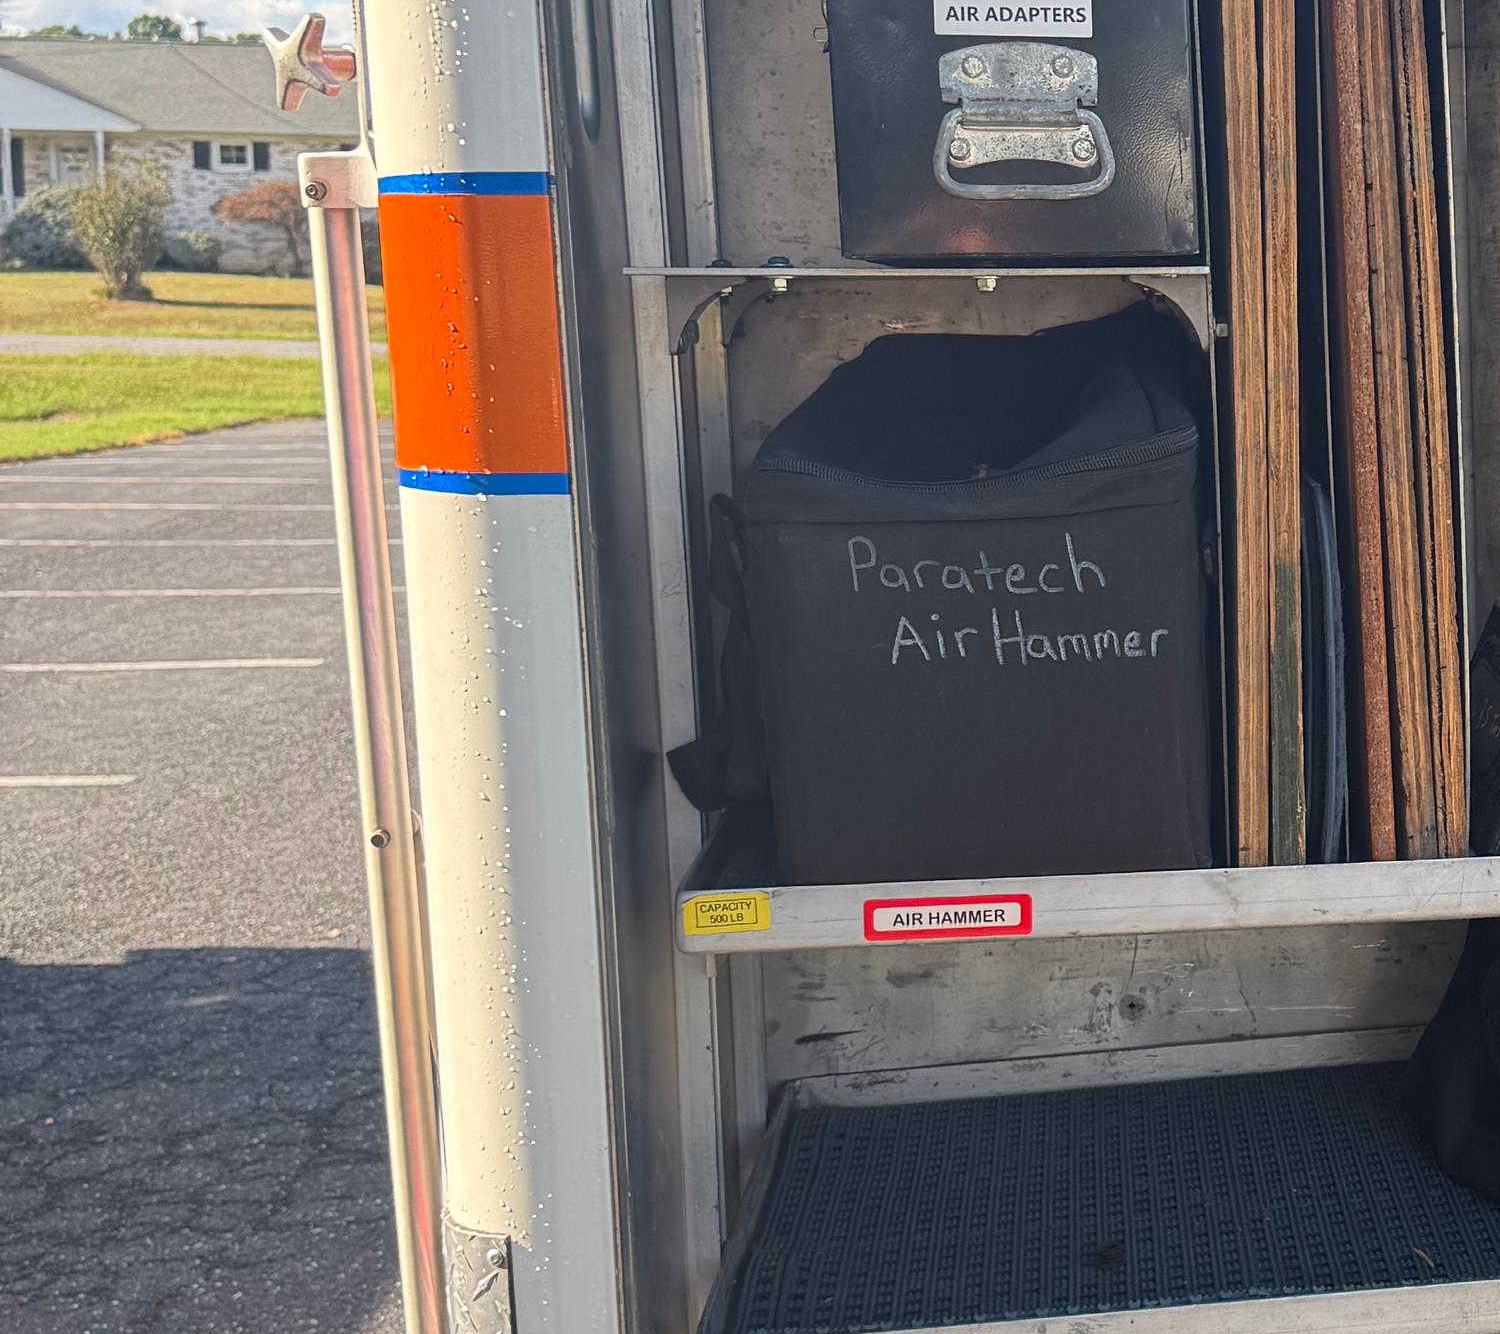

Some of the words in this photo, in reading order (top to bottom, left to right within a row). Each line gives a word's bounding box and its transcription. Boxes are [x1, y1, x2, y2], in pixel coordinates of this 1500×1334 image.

[945, 5, 979, 22] AIR
[985, 7, 1087, 23] ADAPTERS
[848, 532, 1106, 594] Paratech
[892, 613, 978, 665] Air
[992, 607, 1169, 665] Hammer
[700, 901, 752, 913] CAPACITY
[710, 914, 728, 924] 500
[730, 913, 744, 922] LB
[892, 912, 923, 927] AIR
[928, 909, 1006, 925] HAMMER
